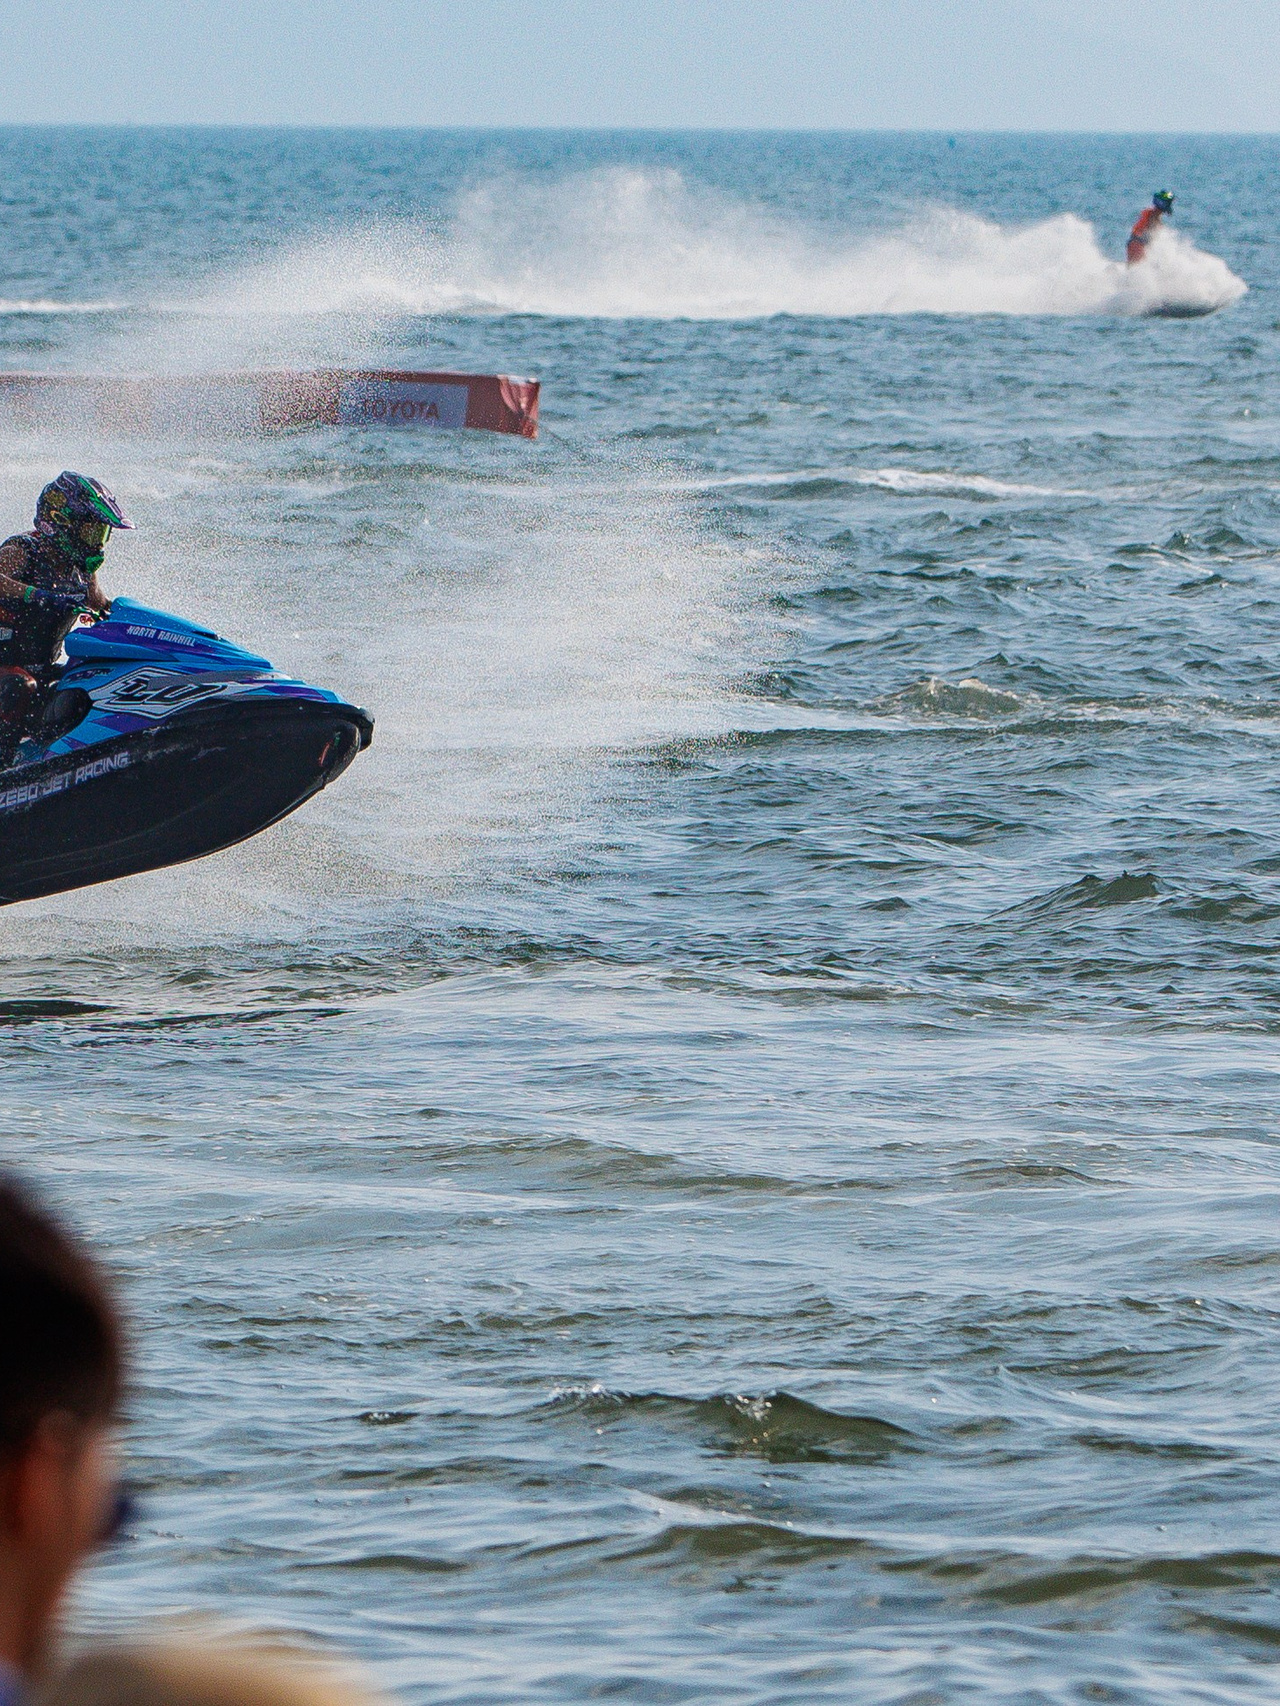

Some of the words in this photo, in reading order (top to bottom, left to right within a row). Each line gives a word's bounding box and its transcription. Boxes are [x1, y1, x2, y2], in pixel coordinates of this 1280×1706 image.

[126, 625, 157, 639] NORTH
[157, 630, 196, 647] RAINHILL
[41, 771, 72, 796] JET
[74, 751, 129, 785] RACING
